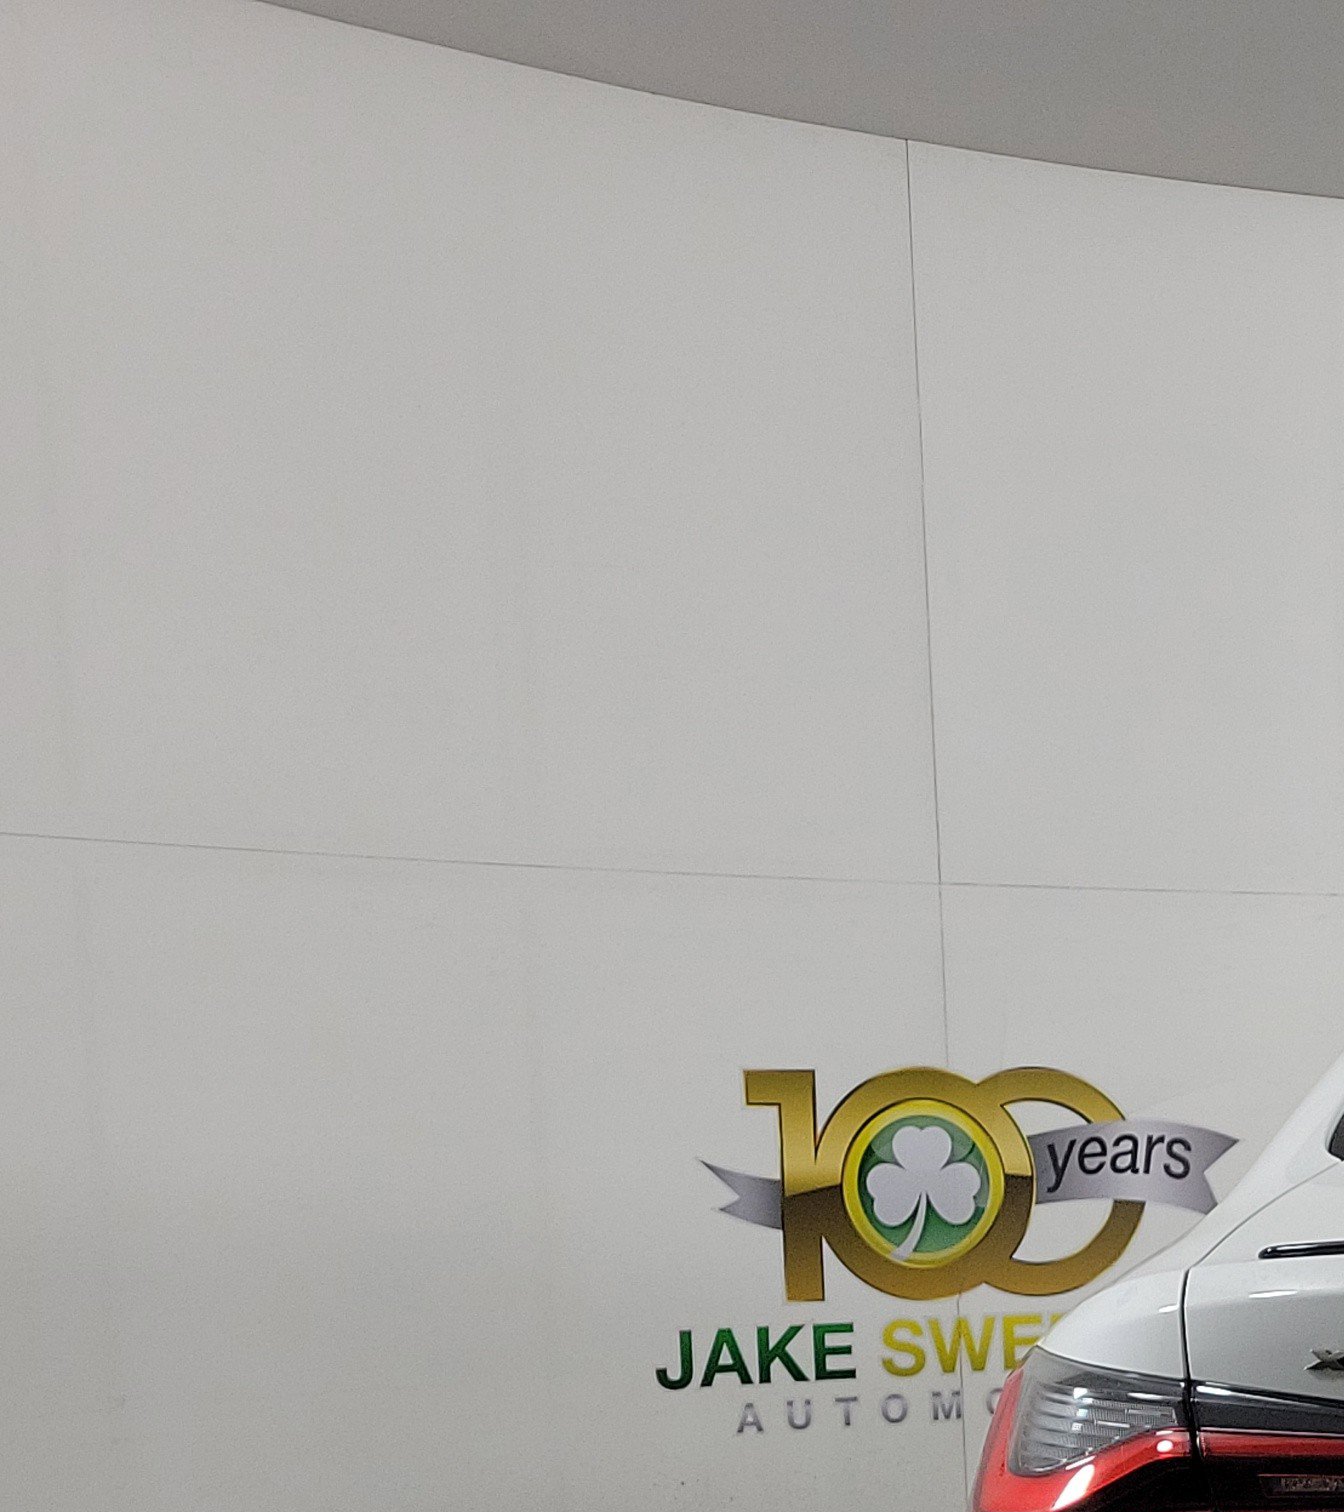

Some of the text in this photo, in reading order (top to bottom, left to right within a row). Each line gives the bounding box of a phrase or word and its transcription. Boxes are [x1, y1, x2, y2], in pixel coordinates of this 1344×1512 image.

[743, 1066, 1147, 1302] 100
[1046, 1133, 1193, 1193] years
[655, 1312, 1068, 1390] JAKE SWE
